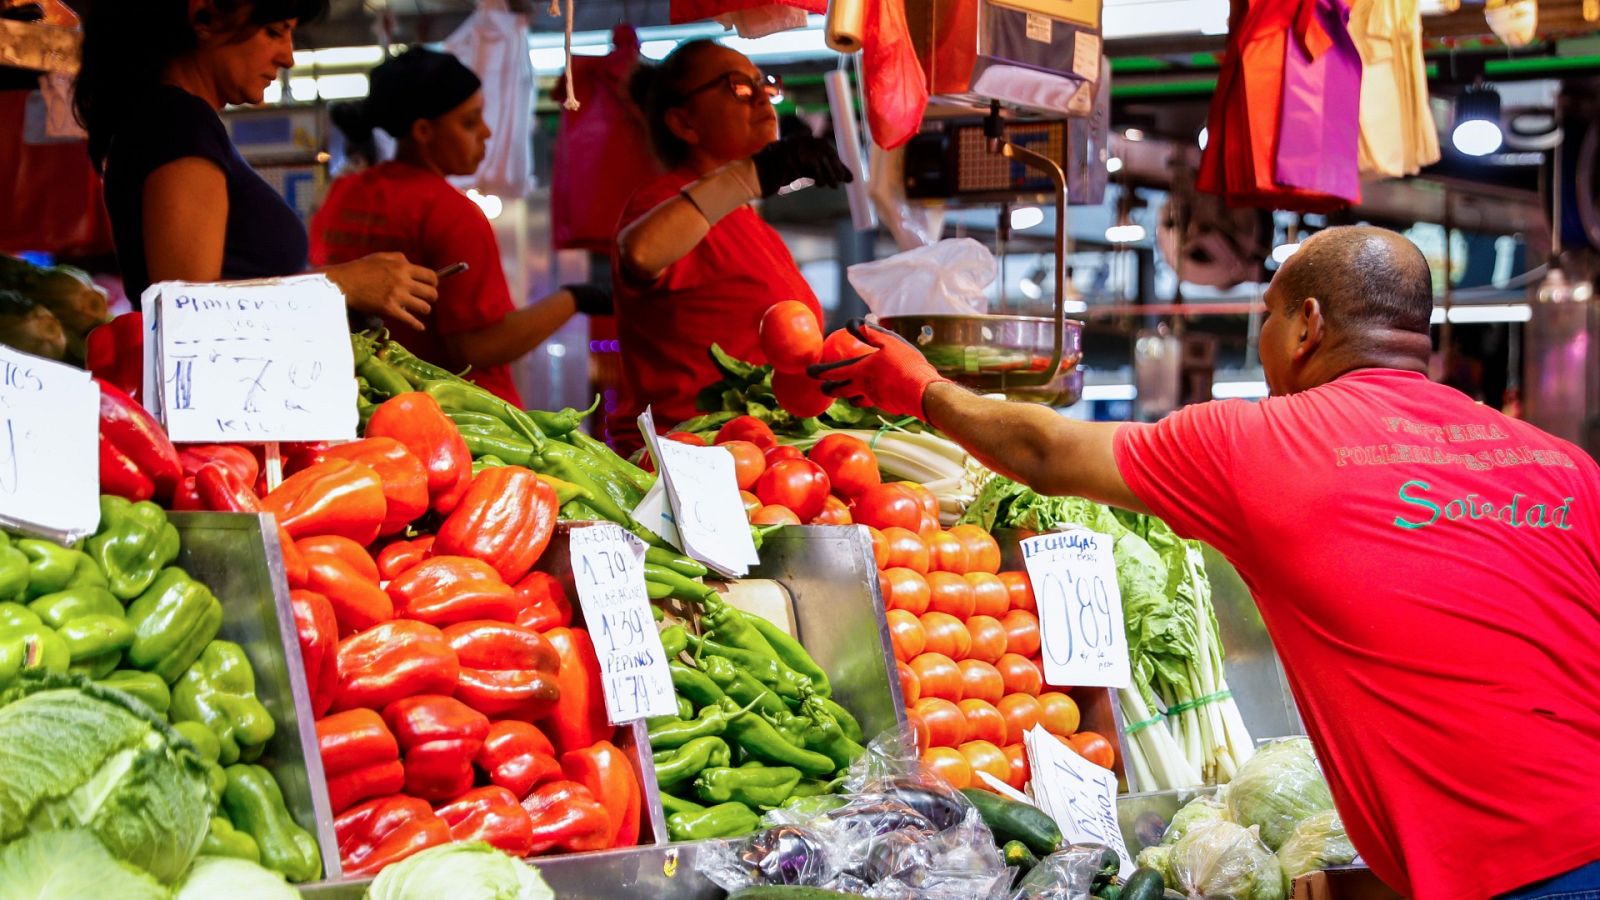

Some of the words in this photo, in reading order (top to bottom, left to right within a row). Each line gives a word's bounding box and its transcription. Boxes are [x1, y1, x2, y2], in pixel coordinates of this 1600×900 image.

[1393, 479, 1574, 530] Soledad
[1024, 535, 1098, 558] LECHUGAS
[1042, 569, 1113, 666] 0'89
[607, 648, 654, 674] PEPINOS
